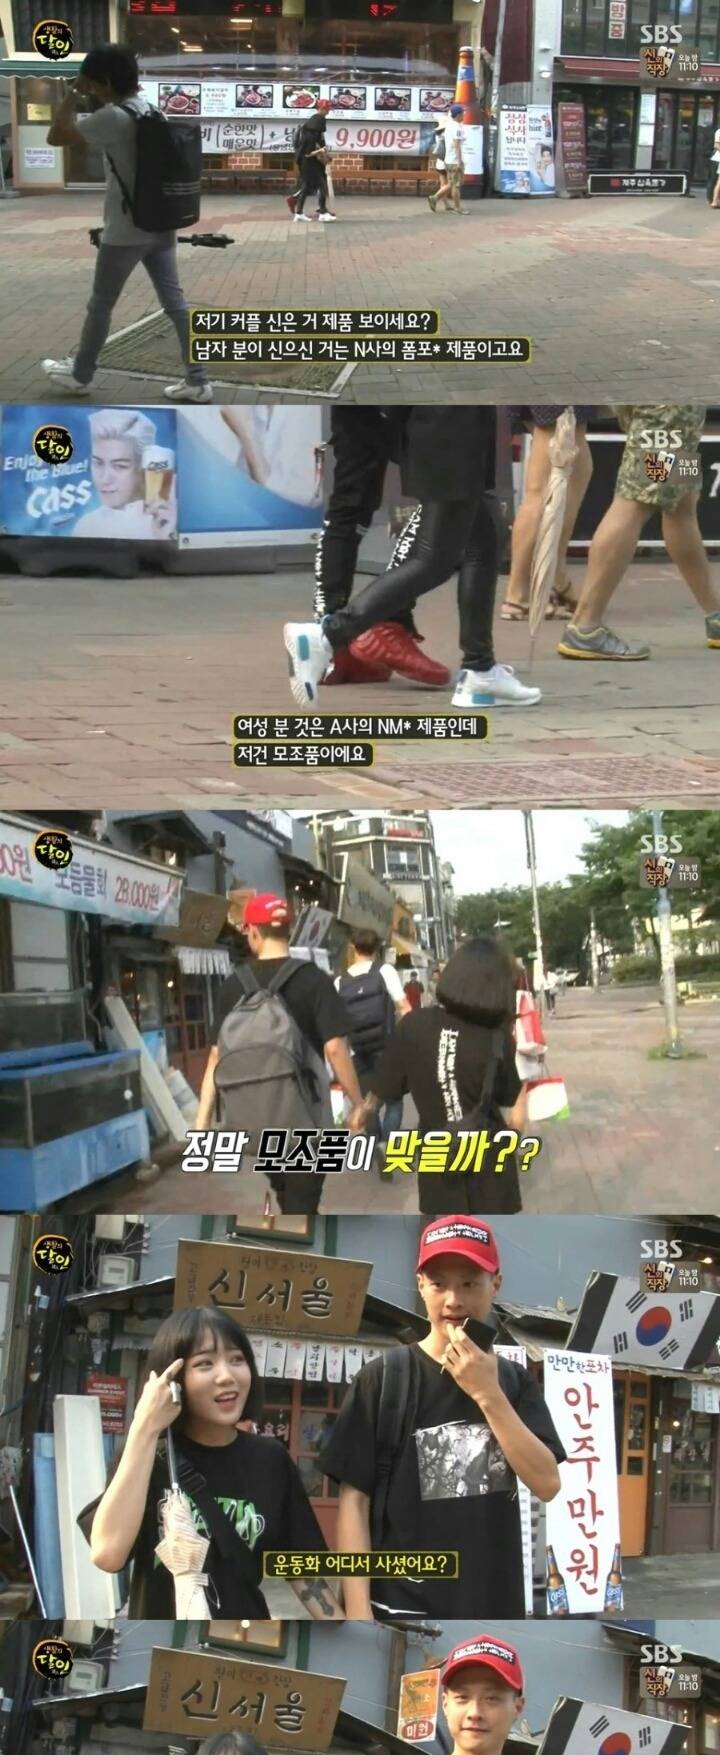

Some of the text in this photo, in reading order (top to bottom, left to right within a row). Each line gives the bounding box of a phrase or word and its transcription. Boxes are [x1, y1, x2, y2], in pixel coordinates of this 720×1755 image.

[336, 128, 416, 148] 9,900원
[208, 1268, 334, 1320] 신서울
[548, 1355, 610, 1374] 만만한포차
[181, 1680, 307, 1734] 신서울
[406, 1723, 430, 1738] 미원
